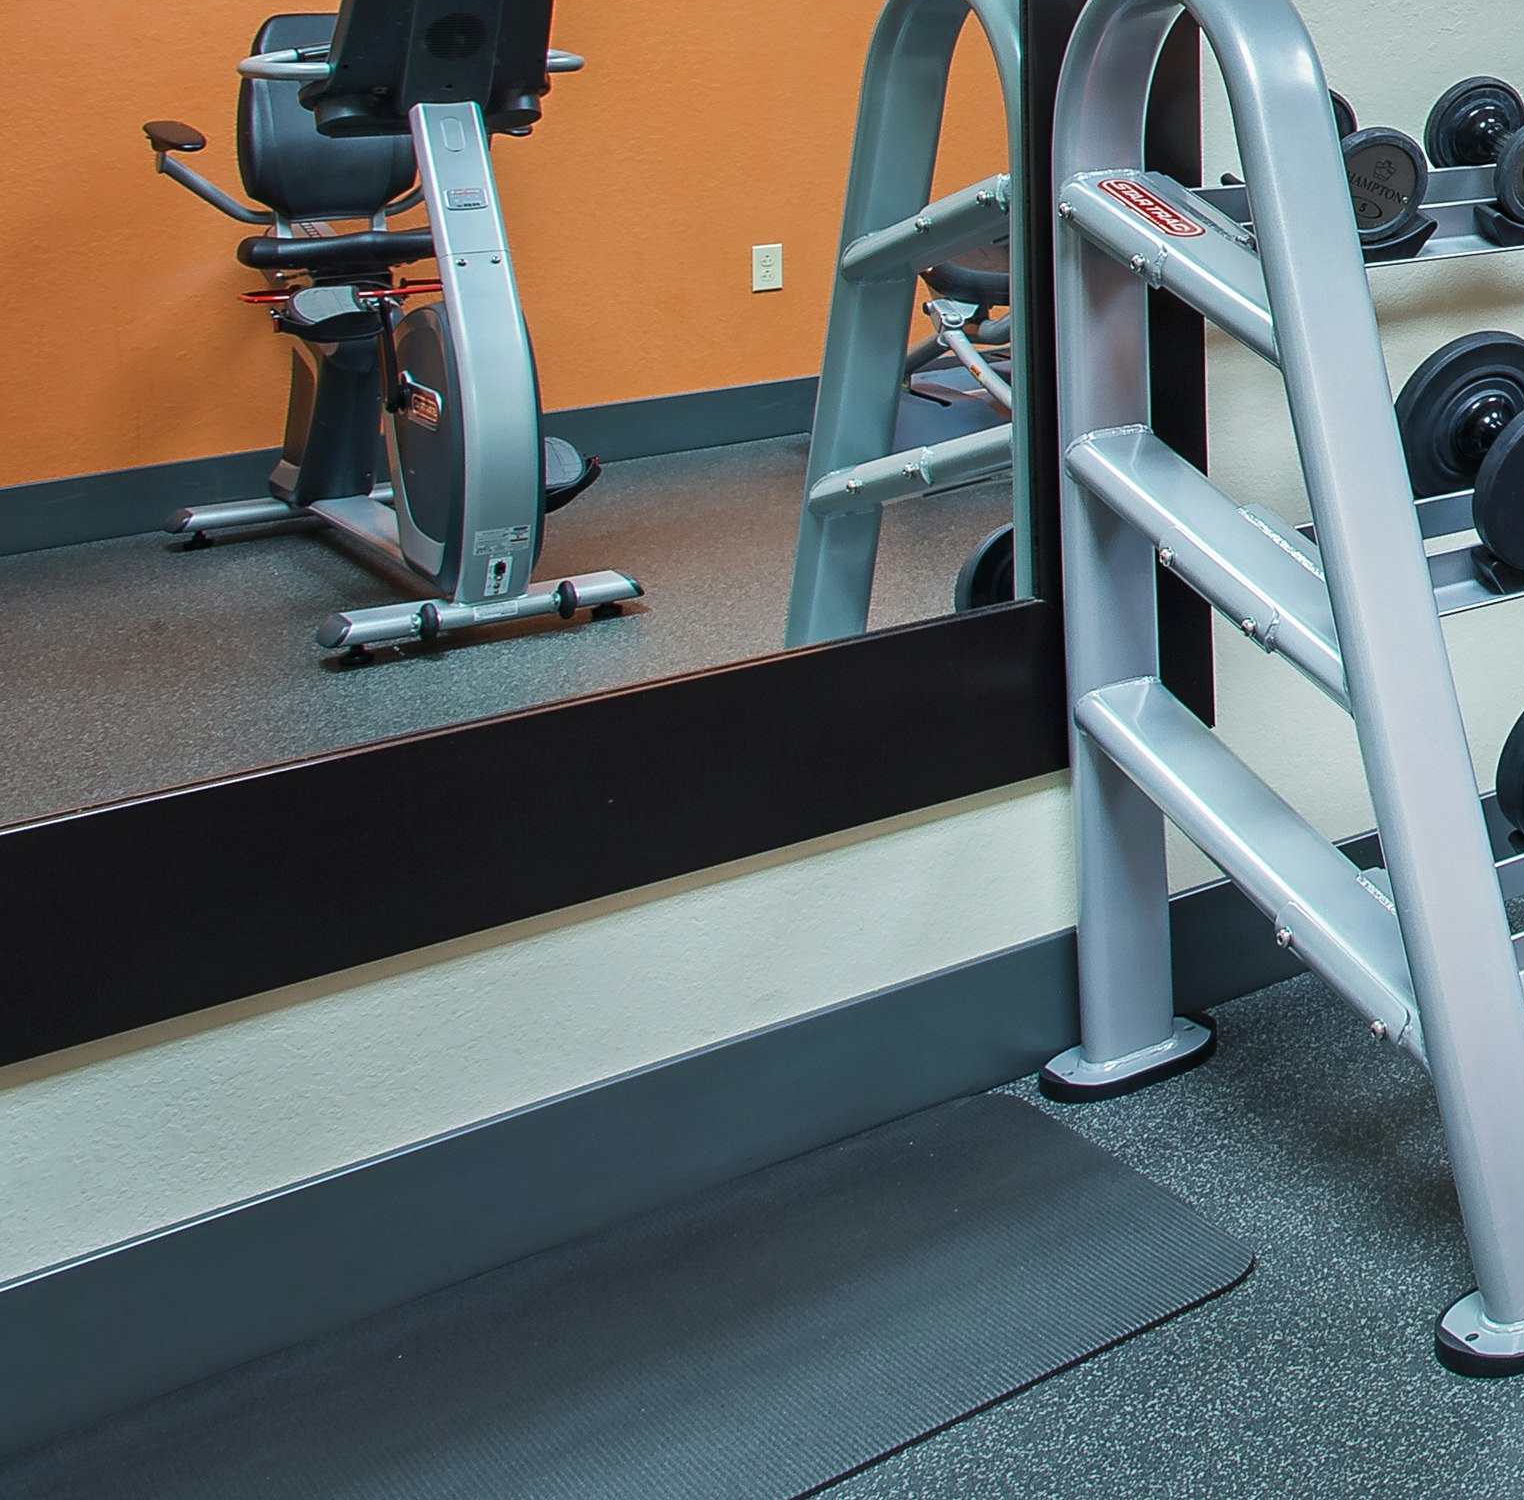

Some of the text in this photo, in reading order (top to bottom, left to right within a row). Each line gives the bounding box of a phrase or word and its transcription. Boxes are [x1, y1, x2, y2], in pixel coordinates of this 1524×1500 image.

[1110, 181, 1192, 233] STAR TRAC
[1359, 203, 1368, 213] 5
